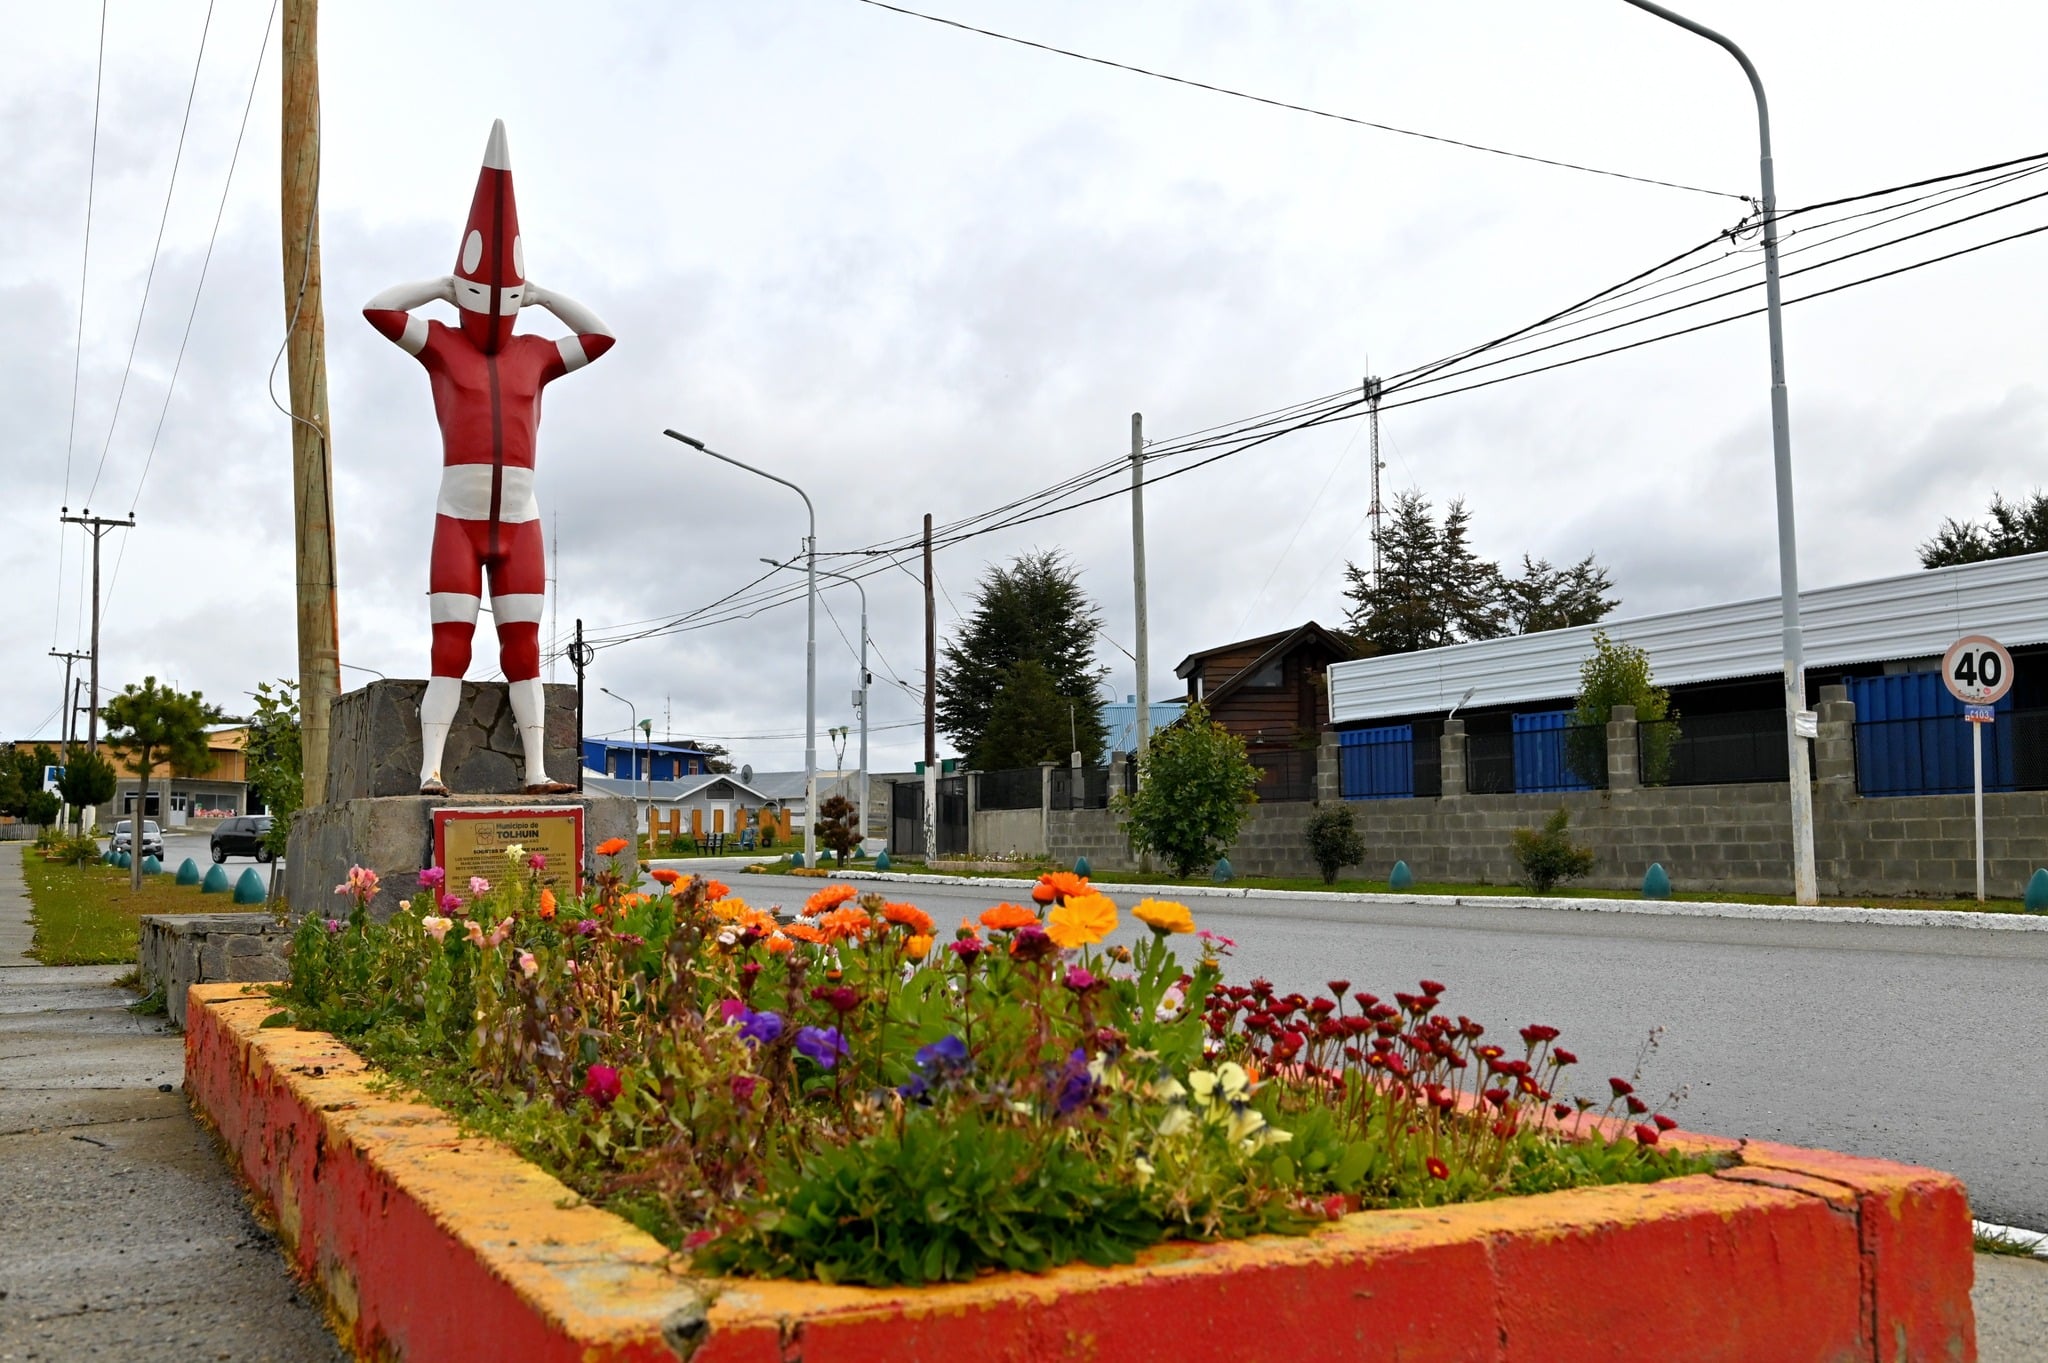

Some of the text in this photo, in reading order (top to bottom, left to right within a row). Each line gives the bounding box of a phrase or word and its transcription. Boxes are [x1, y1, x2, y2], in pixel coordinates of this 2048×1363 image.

[1954, 651, 2002, 687] 40
[496, 822, 528, 830] Municipio
[496, 830, 539, 839] TOLHUIN
